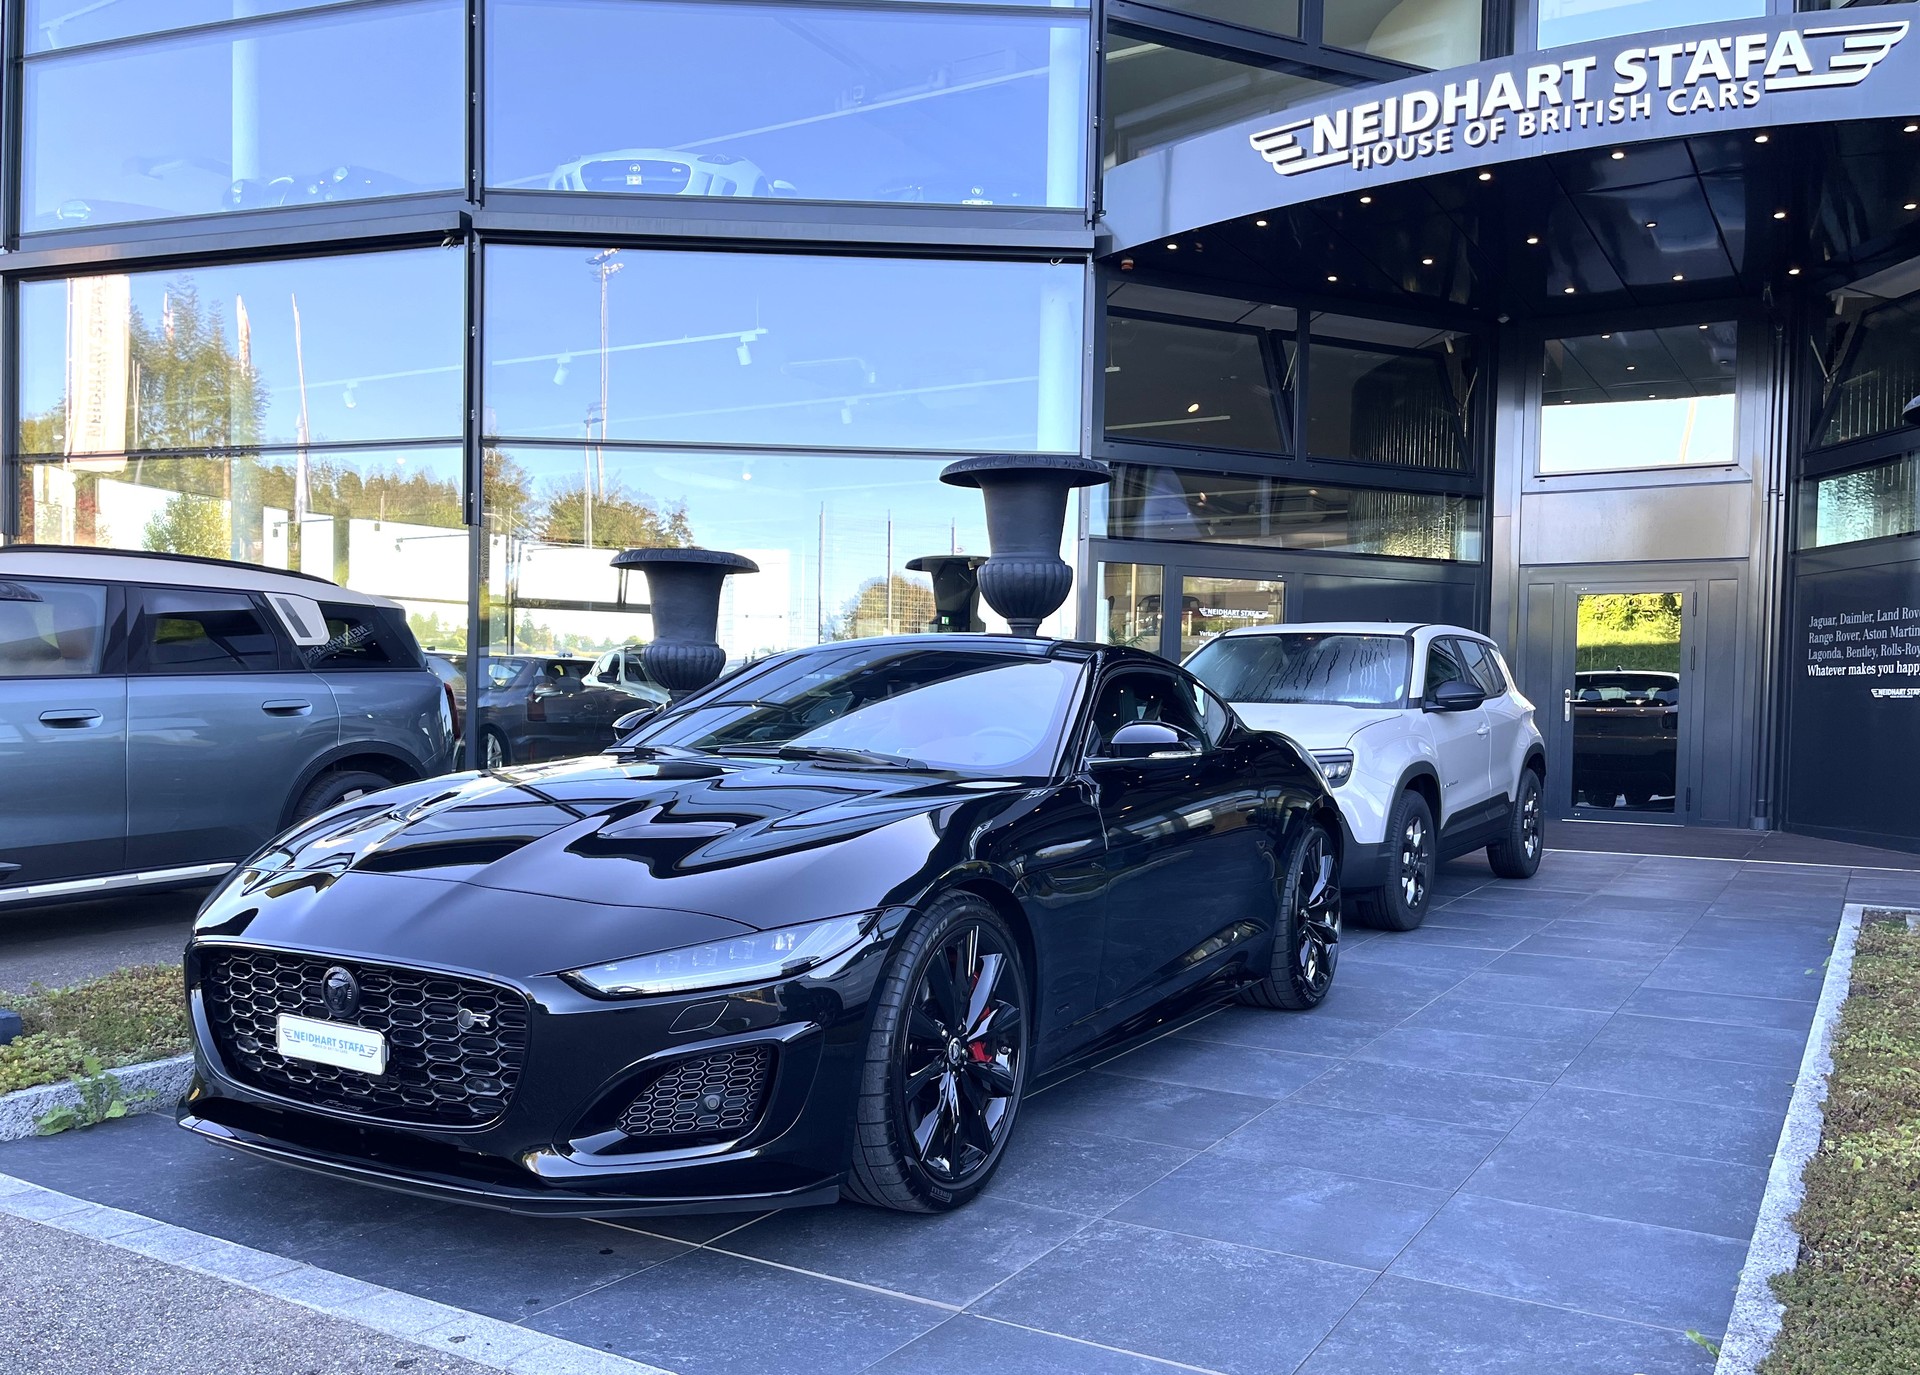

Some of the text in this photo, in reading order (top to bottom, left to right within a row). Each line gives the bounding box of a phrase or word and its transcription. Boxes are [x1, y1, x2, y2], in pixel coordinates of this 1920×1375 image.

[1313, 30, 1814, 154] NEIDHART STÄFA
[1352, 81, 1761, 170] HOUSE OF BRITISH CARS
[1207, 608, 1240, 616] NEIDHART
[1809, 606, 1920, 629] Jaguar, Daimler, Land Rov
[1808, 632, 1834, 645] Range
[1836, 630, 1861, 642] Rover,
[1862, 628, 1888, 641] Aston
[1808, 647, 1844, 662] Lagonda,
[1846, 645, 1878, 660] Bentley,
[1807, 660, 1920, 677] Whatever makes you happ
[293, 1030, 336, 1047] NEIDHART
